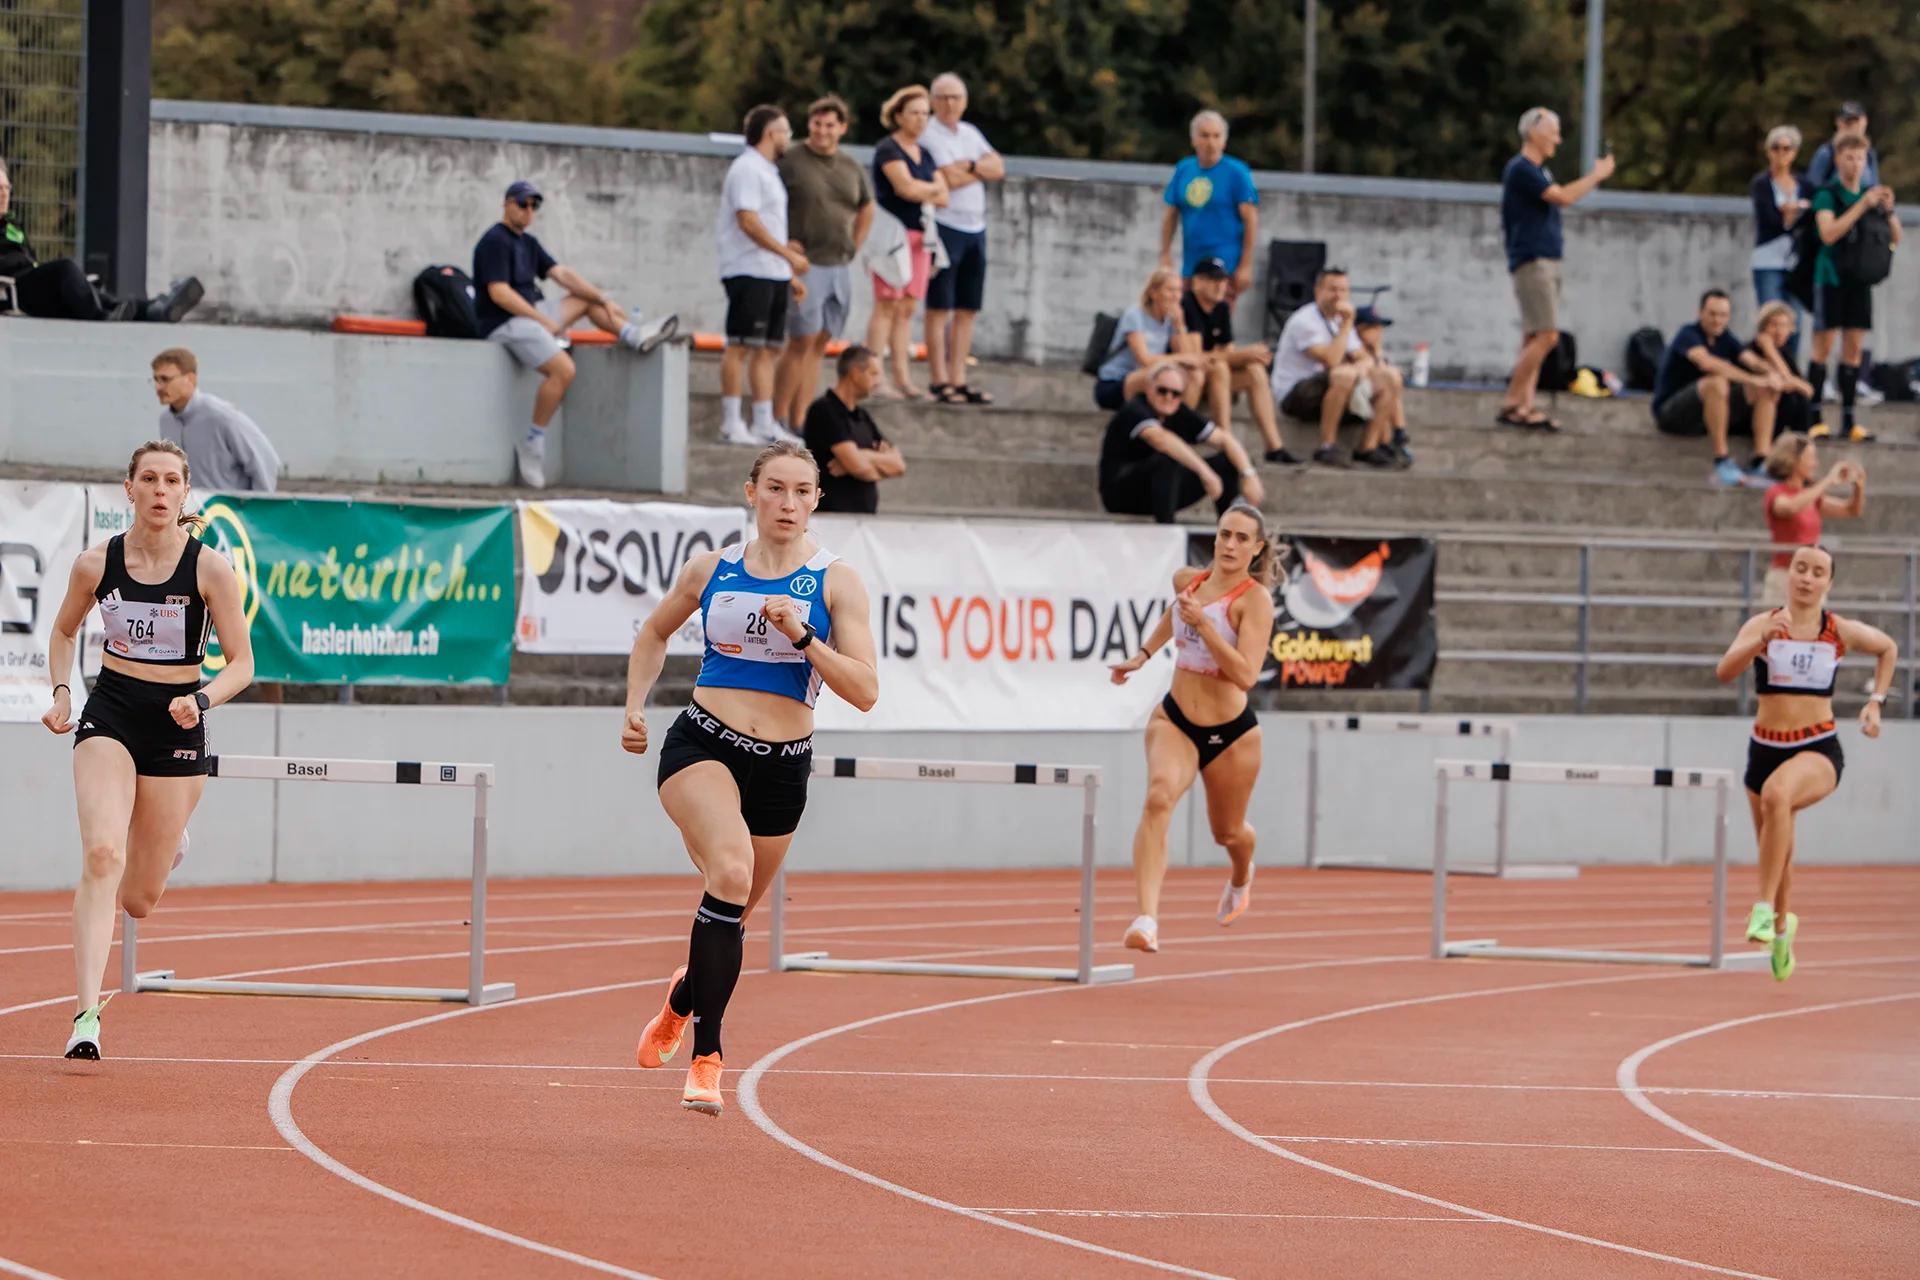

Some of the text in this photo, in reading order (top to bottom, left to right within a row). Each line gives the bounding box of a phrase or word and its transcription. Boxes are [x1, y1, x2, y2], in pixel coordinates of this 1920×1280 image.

[160, 609, 178, 618] UBS
[745, 612, 768, 636] 28
[127, 618, 154, 640] 764
[302, 621, 440, 656] haslerholzbau.ch
[881, 594, 918, 659] IS
[930, 595, 1056, 661] YOUR
[30, 653, 46, 668] AG
[719, 730, 772, 756] PRO
[287, 762, 328, 776] Basel
[918, 765, 955, 778] Basel
